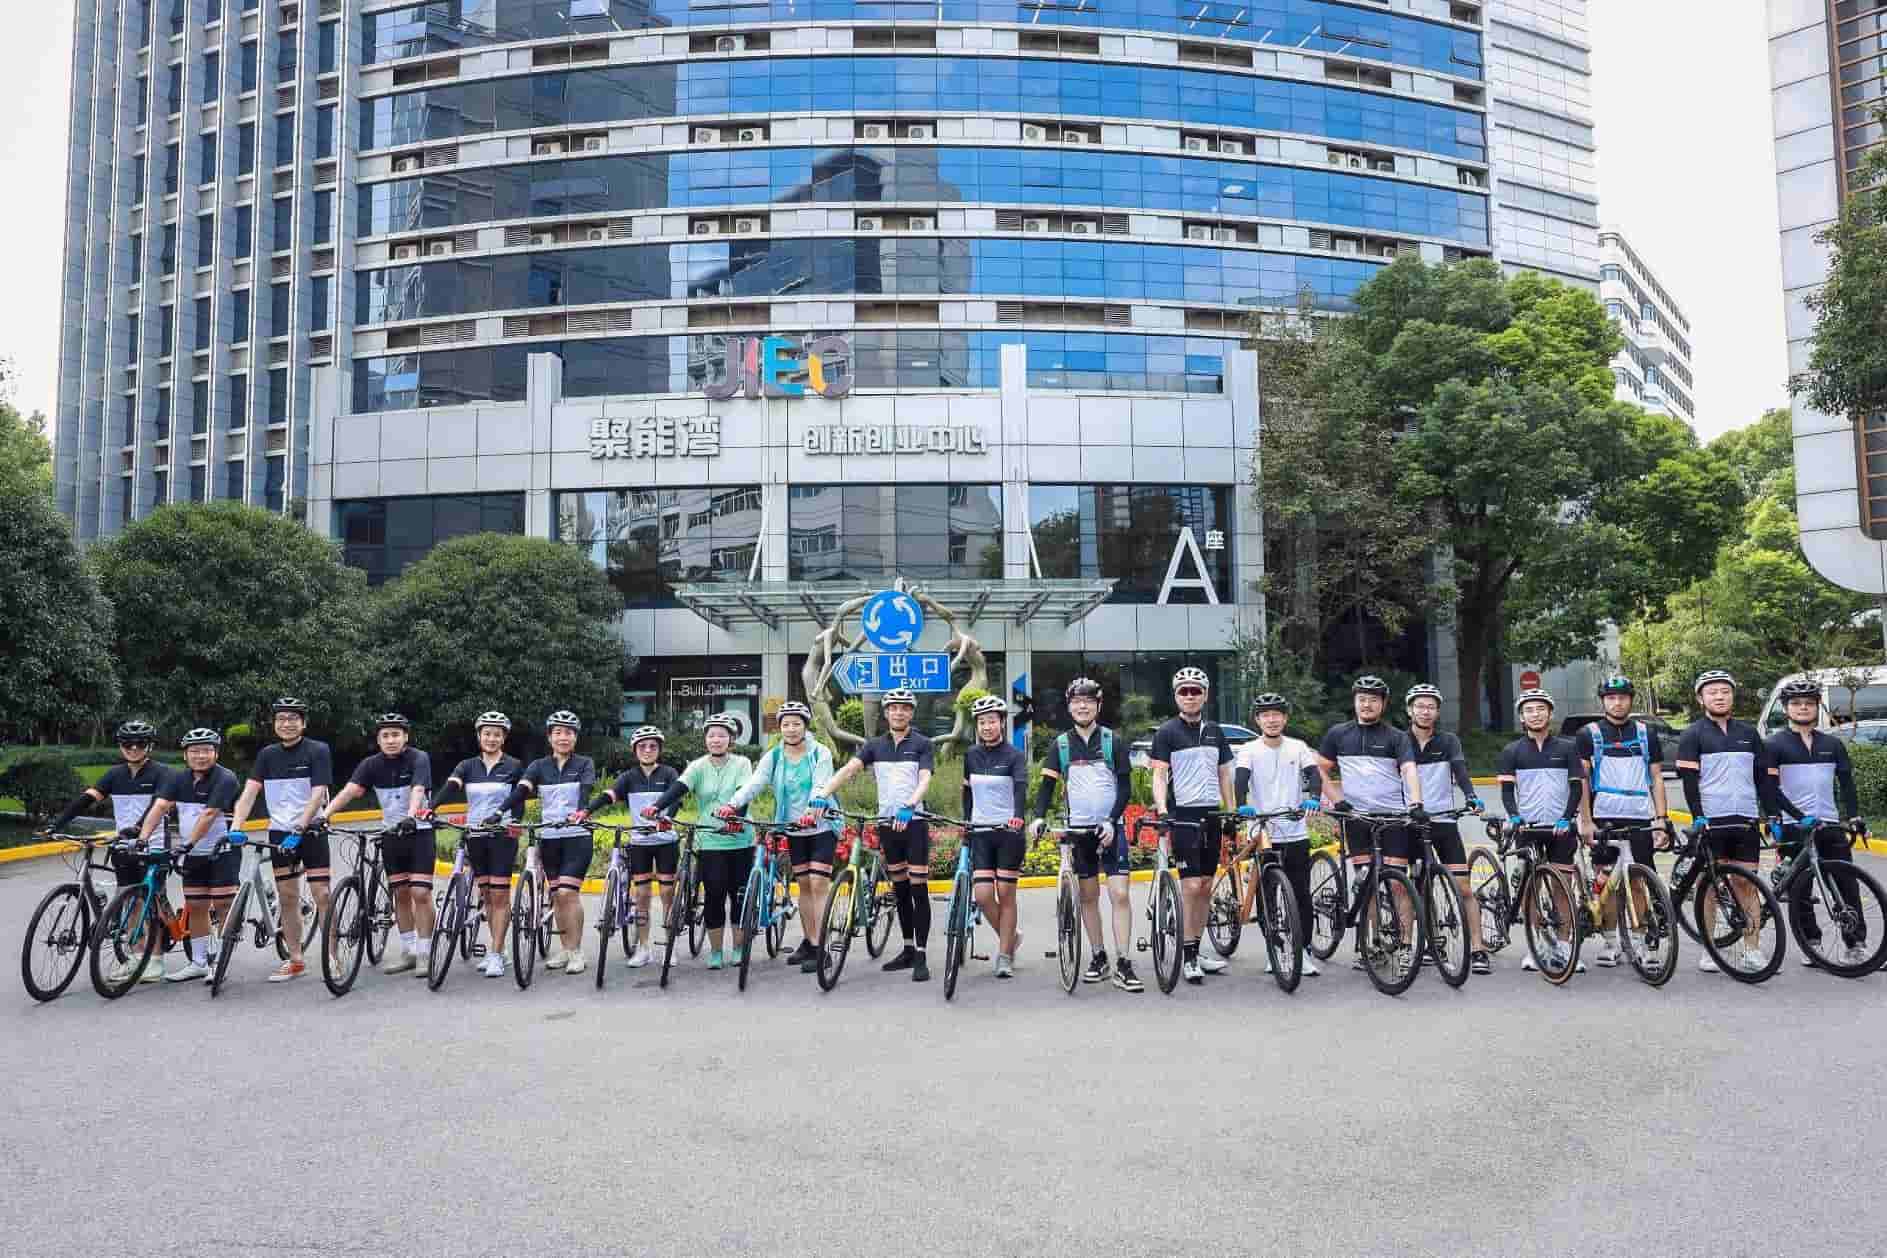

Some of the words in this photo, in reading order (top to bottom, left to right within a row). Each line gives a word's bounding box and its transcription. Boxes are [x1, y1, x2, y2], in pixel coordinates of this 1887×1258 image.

[703, 336, 851, 399] JIEC
[589, 416, 720, 459] 聚能湾
[804, 425, 986, 455] 创新创业中心
[889, 656, 939, 676] 出口
[900, 678, 929, 689] EXIT
